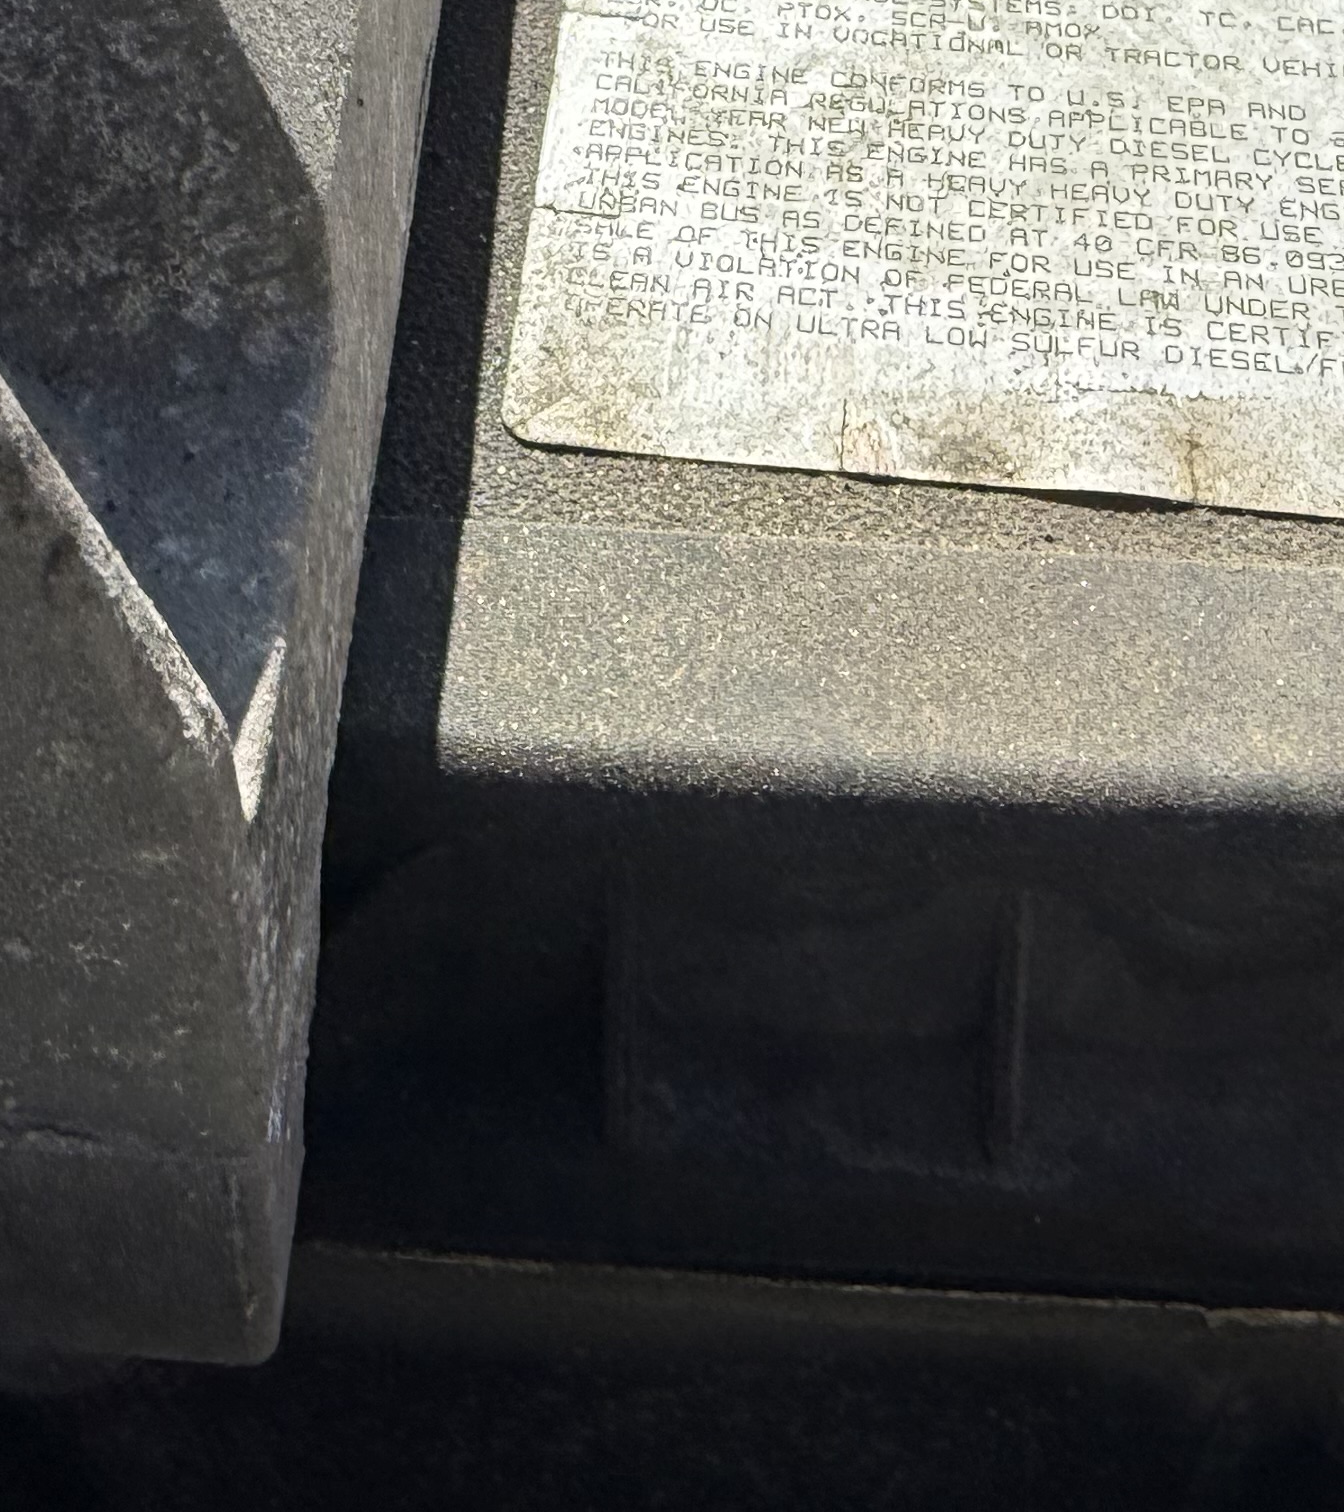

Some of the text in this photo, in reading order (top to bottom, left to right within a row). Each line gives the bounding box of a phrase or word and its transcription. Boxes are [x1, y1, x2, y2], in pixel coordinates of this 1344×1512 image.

[700, 17, 755, 36] USE
[777, 21, 812, 40] IN
[1045, 42, 1083, 61] OR
[1104, 46, 1244, 71] TRACTOR
[596, 73, 788, 106] CALIFORNIA
[809, 92, 1026, 124] REGULATIONS
[1049, 109, 1248, 141] APPLICABLE
[1270, 125, 1309, 146] TO
[695, 60, 807, 85] ENGINE
[830, 71, 985, 98] CONFORMS
[1007, 84, 1045, 102] TO
[1167, 95, 1225, 115] EPA
[1248, 101, 1306, 121] AND
[768, 135, 845, 157] THIS
[866, 141, 986, 168] ENGINE
[1009, 153, 1067, 175] HAS
[1091, 160, 1108, 179] A
[1132, 163, 1272, 190] PRIMARY
[888, 120, 985, 144] HEAVY
[1008, 130, 1087, 152] DUTY
[1110, 138, 1230, 164] DIESEL
[584, 163, 661, 189] THIS
[681, 176, 809, 202] ENGINE
[824, 189, 863, 207] IS
[886, 193, 946, 215] NOT
[968, 198, 1153, 230] CERTIFIED
[1177, 216, 1238, 238] FOR
[1261, 222, 1323, 245] USE
[585, 142, 804, 178] APPLICATION
[826, 164, 863, 183] AS
[886, 167, 903, 187] A
[927, 172, 1027, 196] HEAVY
[1050, 183, 1151, 206] HEAVY
[1174, 190, 1255, 213] DUTY
[677, 225, 717, 245] OF
[740, 229, 819, 254] THIS
[843, 239, 966, 266] ENGINE
[989, 251, 1051, 274] FOR
[1074, 258, 1136, 280] USE
[1162, 265, 1200, 287] IN
[1223, 269, 1264, 291] AN
[701, 201, 758, 223] BUS
[782, 210, 821, 229] AS
[844, 214, 986, 243] DEFINED
[1010, 228, 1048, 248] AT
[1073, 232, 1113, 253] 40
[1136, 238, 1199, 261] CFR
[632, 245, 652, 266] A
[675, 249, 860, 284] VIOLATION
[883, 268, 922, 289] OF
[947, 273, 1093, 304] FEDERAL
[1205, 293, 1310, 320] UNDER
[693, 278, 754, 302] AIR
[884, 294, 967, 320] THIS
[990, 303, 1118, 331] ENGINE
[1146, 316, 1182, 337] IS
[733, 307, 773, 331] ON
[796, 314, 900, 341] ULTRA
[925, 325, 987, 348] LOW
[1011, 331, 1140, 360] SULFUR
